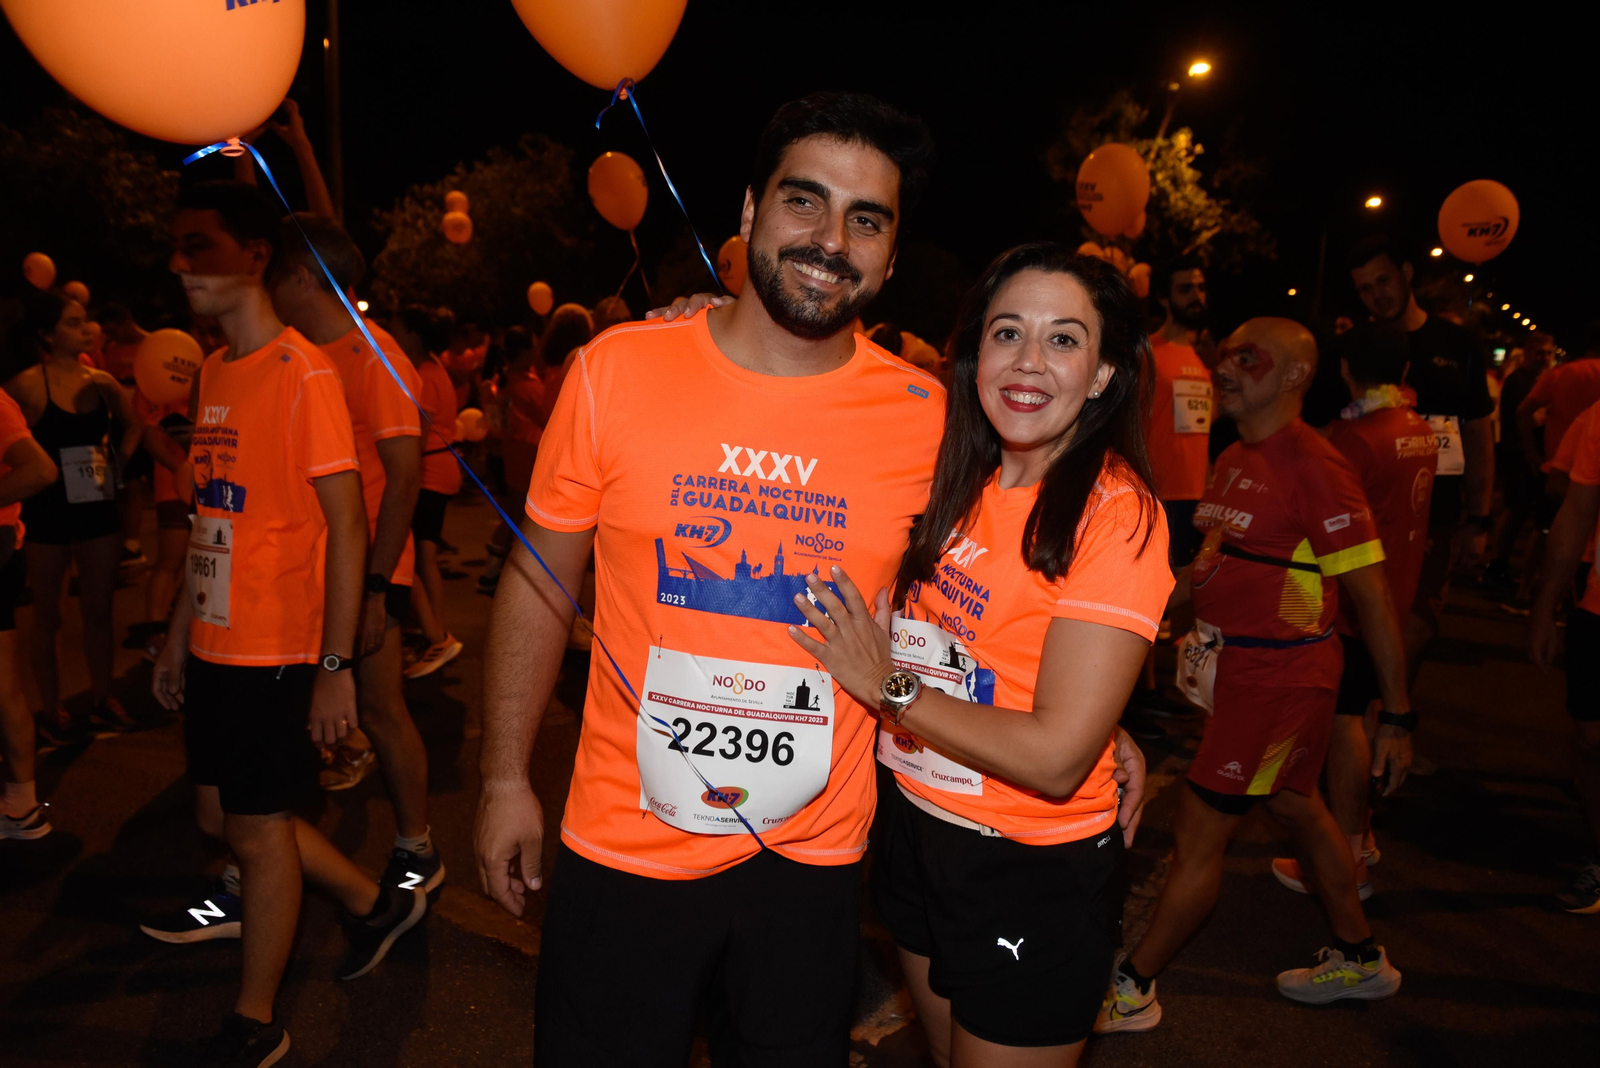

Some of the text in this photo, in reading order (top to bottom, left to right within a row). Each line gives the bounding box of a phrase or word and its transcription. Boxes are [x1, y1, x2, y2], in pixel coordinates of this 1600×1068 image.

[717, 443, 818, 486] XXXV
[670, 487, 680, 506] DEL
[672, 473, 848, 510] CARRERA NOCTURNA
[682, 490, 848, 529] GUADALQUIVIR
[660, 592, 687, 606] 2023
[931, 572, 985, 622] ALQUIVIR
[940, 563, 990, 603] NOCTURNA
[911, 664, 949, 679] GUADALQUIVIR
[651, 693, 668, 703] XXXV
[668, 696, 695, 710] CARRERA
[695, 703, 733, 715] NOCTURNA
[733, 709, 745, 717] DEL
[746, 710, 794, 721] GUADALQUIVIR
[667, 717, 795, 767] 22396
[931, 769, 974, 786] Cruzcampo
